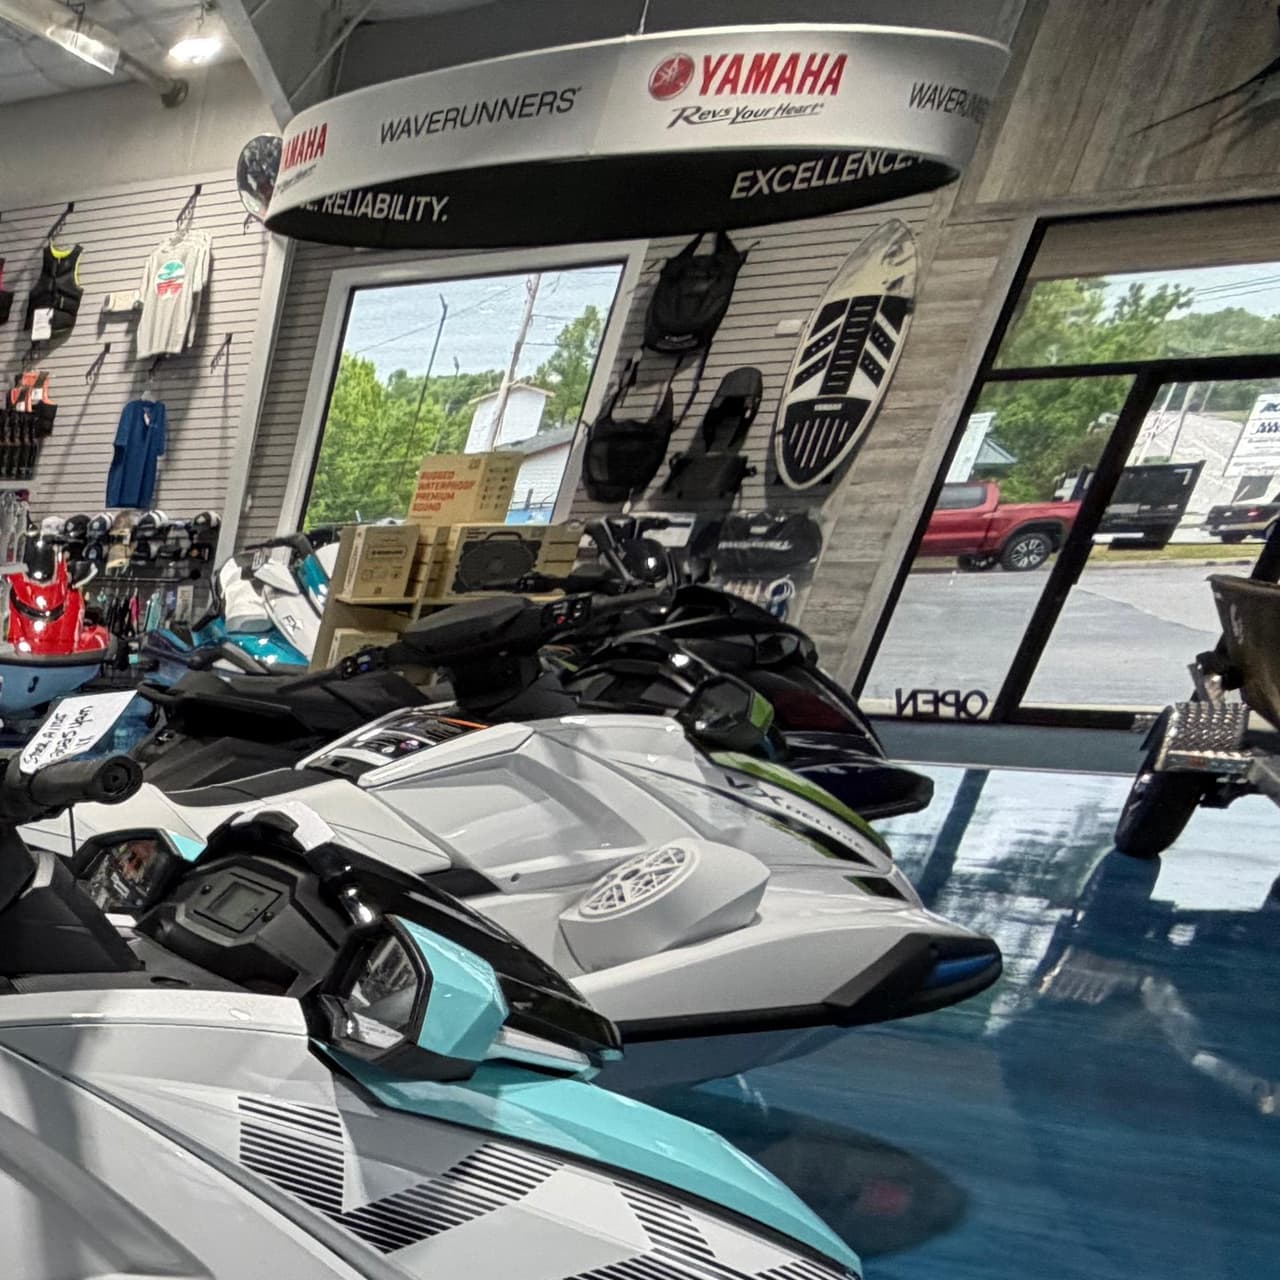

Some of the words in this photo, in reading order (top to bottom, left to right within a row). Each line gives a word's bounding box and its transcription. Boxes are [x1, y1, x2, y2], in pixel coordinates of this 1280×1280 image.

[698, 52, 849, 97] YAMAHA
[667, 105, 731, 129] Revs
[729, 105, 772, 126] Your
[772, 102, 824, 118] Heart
